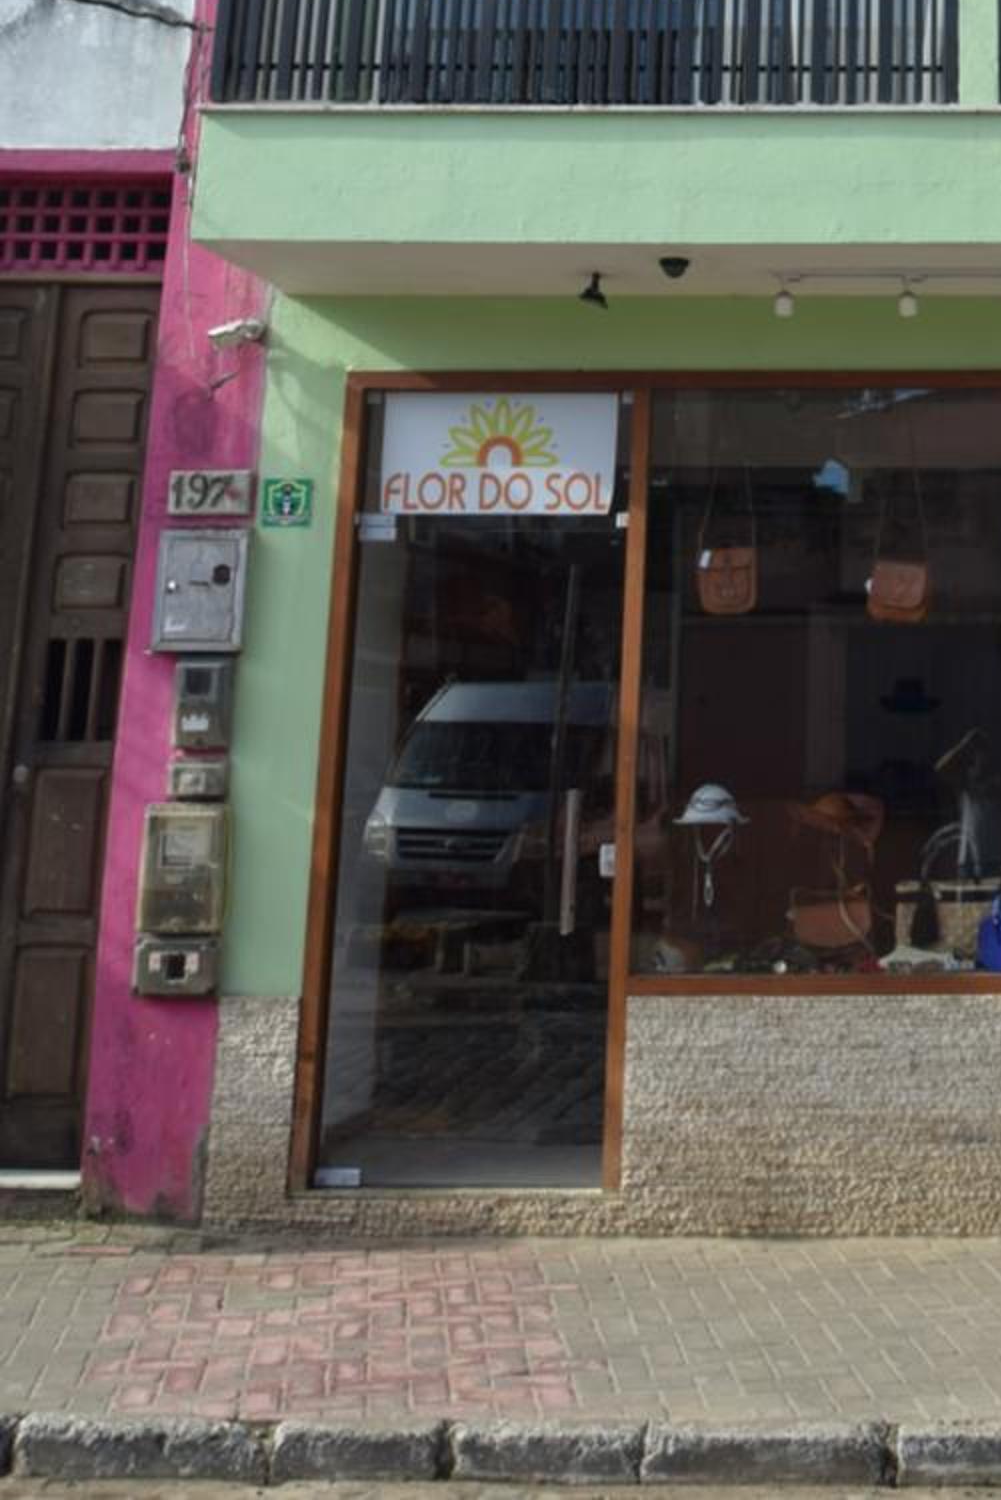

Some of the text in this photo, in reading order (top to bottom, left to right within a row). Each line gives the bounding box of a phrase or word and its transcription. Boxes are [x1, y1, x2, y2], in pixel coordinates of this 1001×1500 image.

[383, 472, 606, 510] FLOR DO SOL
